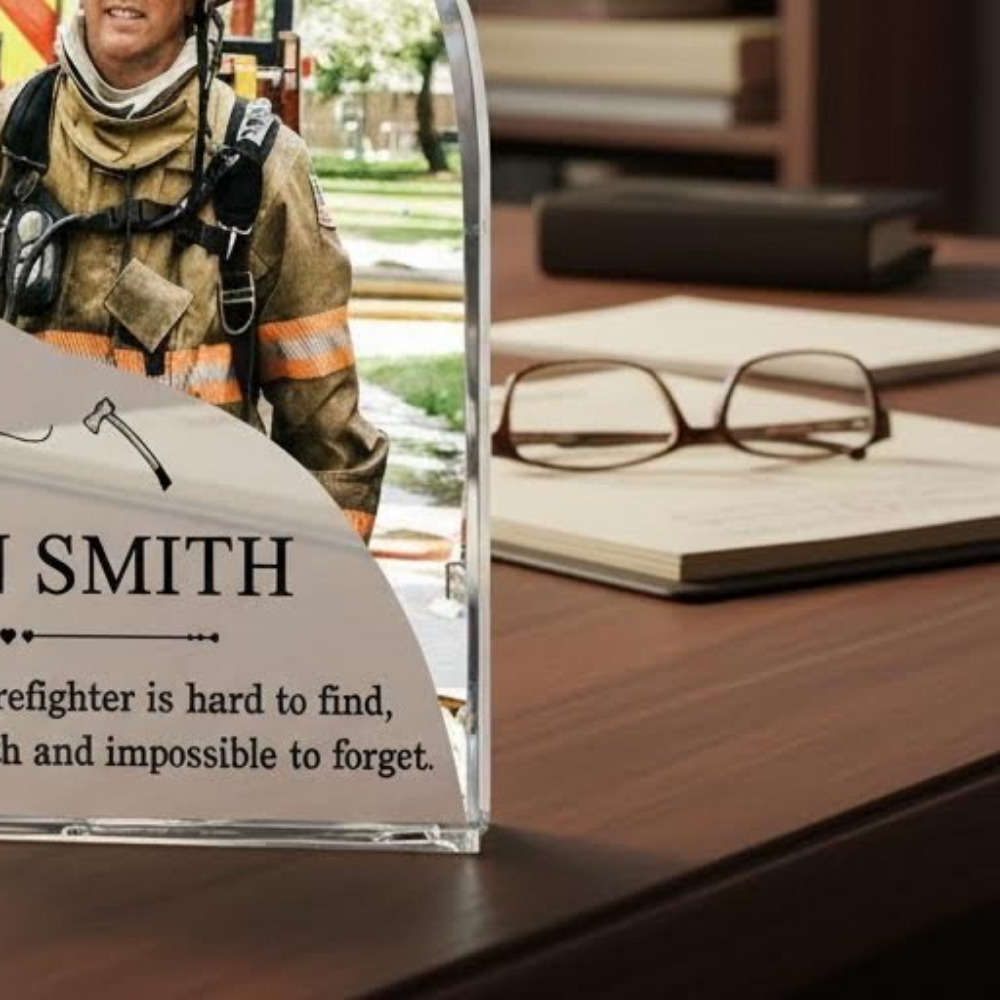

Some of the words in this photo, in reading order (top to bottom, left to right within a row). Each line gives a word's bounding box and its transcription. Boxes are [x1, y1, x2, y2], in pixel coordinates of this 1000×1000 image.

[36, 534, 295, 597] SMITH
[147, 681, 174, 714] is
[186, 682, 266, 715] hard
[275, 686, 307, 716] to
[318, 684, 394, 723] find,
[33, 734, 95, 767] and
[104, 735, 278, 775] impossible
[289, 740, 321, 770] to
[332, 737, 434, 779] forget.
